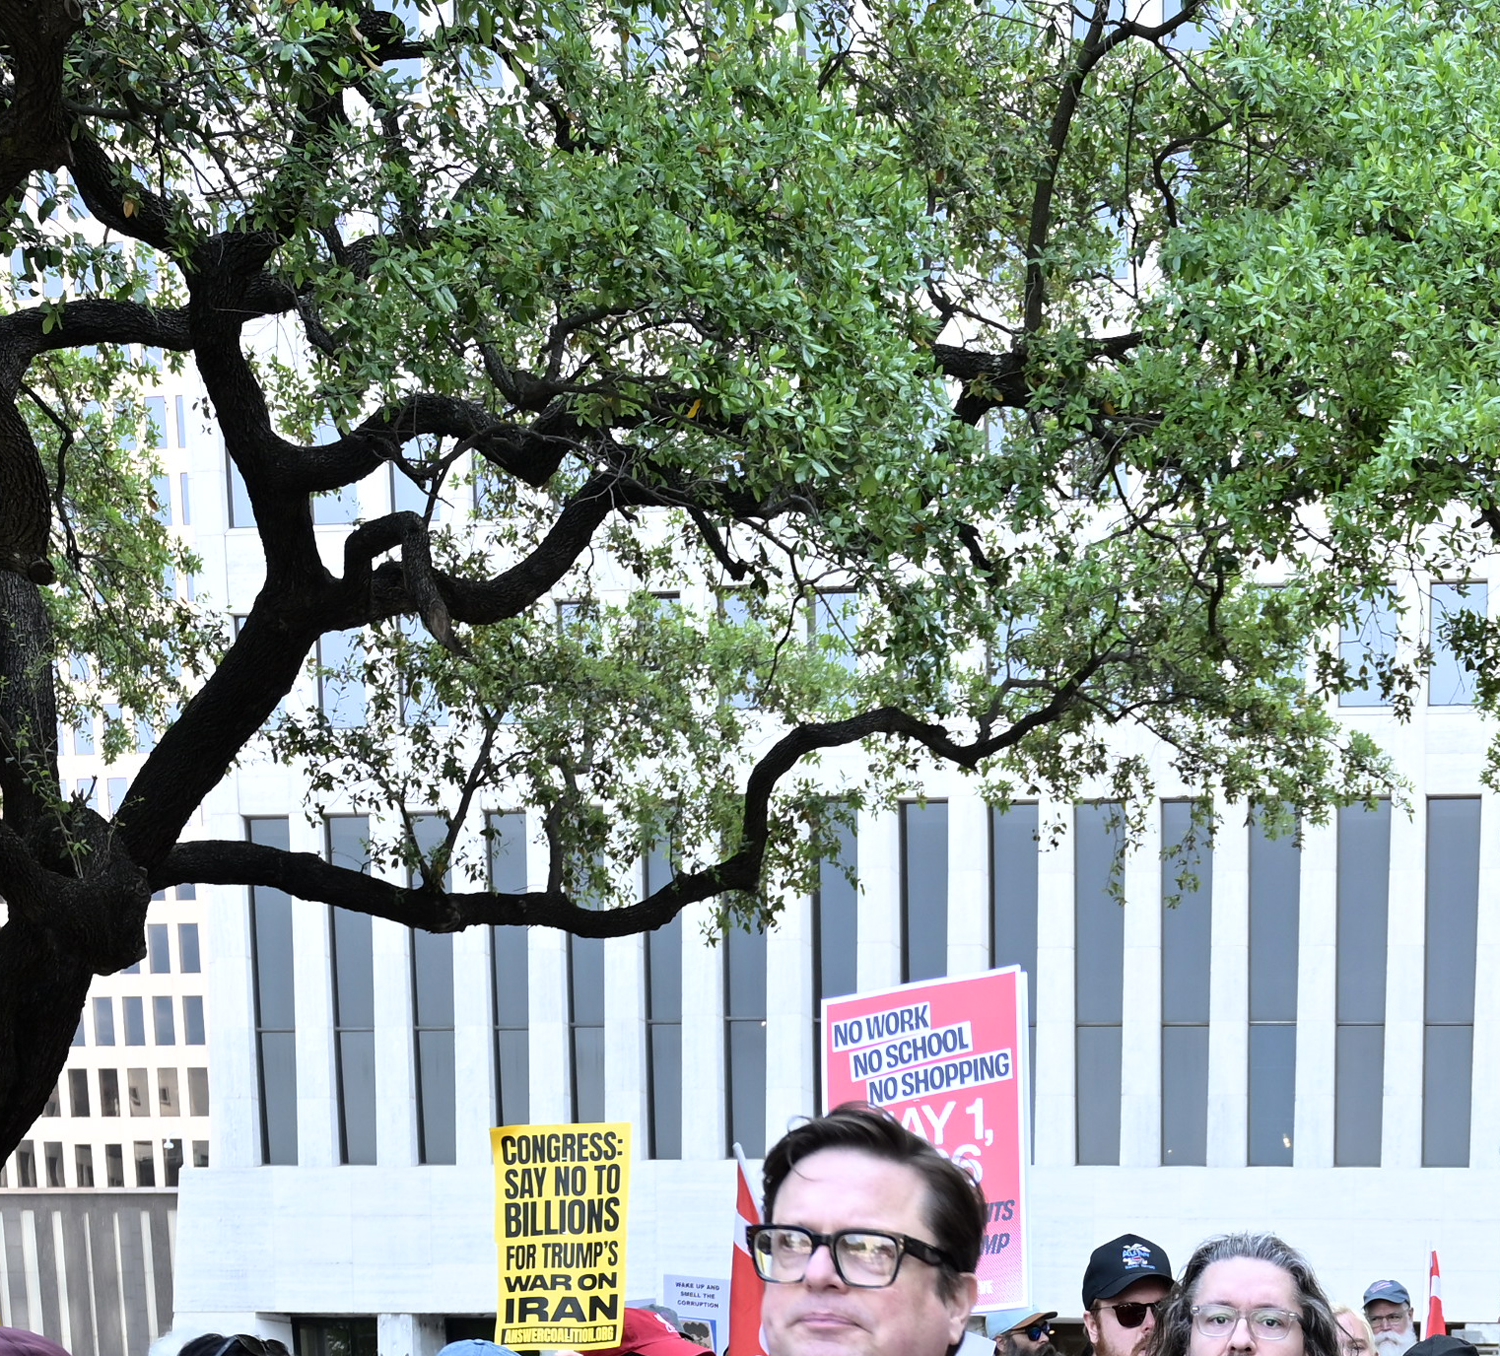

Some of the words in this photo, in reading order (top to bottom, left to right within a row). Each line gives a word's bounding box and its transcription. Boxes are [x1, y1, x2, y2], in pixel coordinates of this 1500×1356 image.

[833, 1020, 863, 1048] NO
[866, 1004, 929, 1041] WORK
[852, 1049, 883, 1078] NO
[886, 1026, 969, 1069] SCHOOL
[868, 1076, 898, 1106] NO
[901, 1052, 1010, 1097] SHOPPING
[890, 1100, 956, 1145] AY
[965, 1097, 995, 1147] 1,
[501, 1131, 623, 1165] CONGRESS:
[505, 1167, 547, 1199] SAY
[555, 1165, 586, 1196] NO
[594, 1164, 621, 1195] TO
[505, 1197, 620, 1238] BILLIONS
[506, 1244, 536, 1270] FOR
[504, 1274, 572, 1292] WAR
[578, 1272, 617, 1290] ON
[505, 1294, 618, 1324] IRAN
[677, 1300, 719, 1308] CORRUPTION
[504, 1326, 614, 1344] ANSWERCOALITION.ORG
